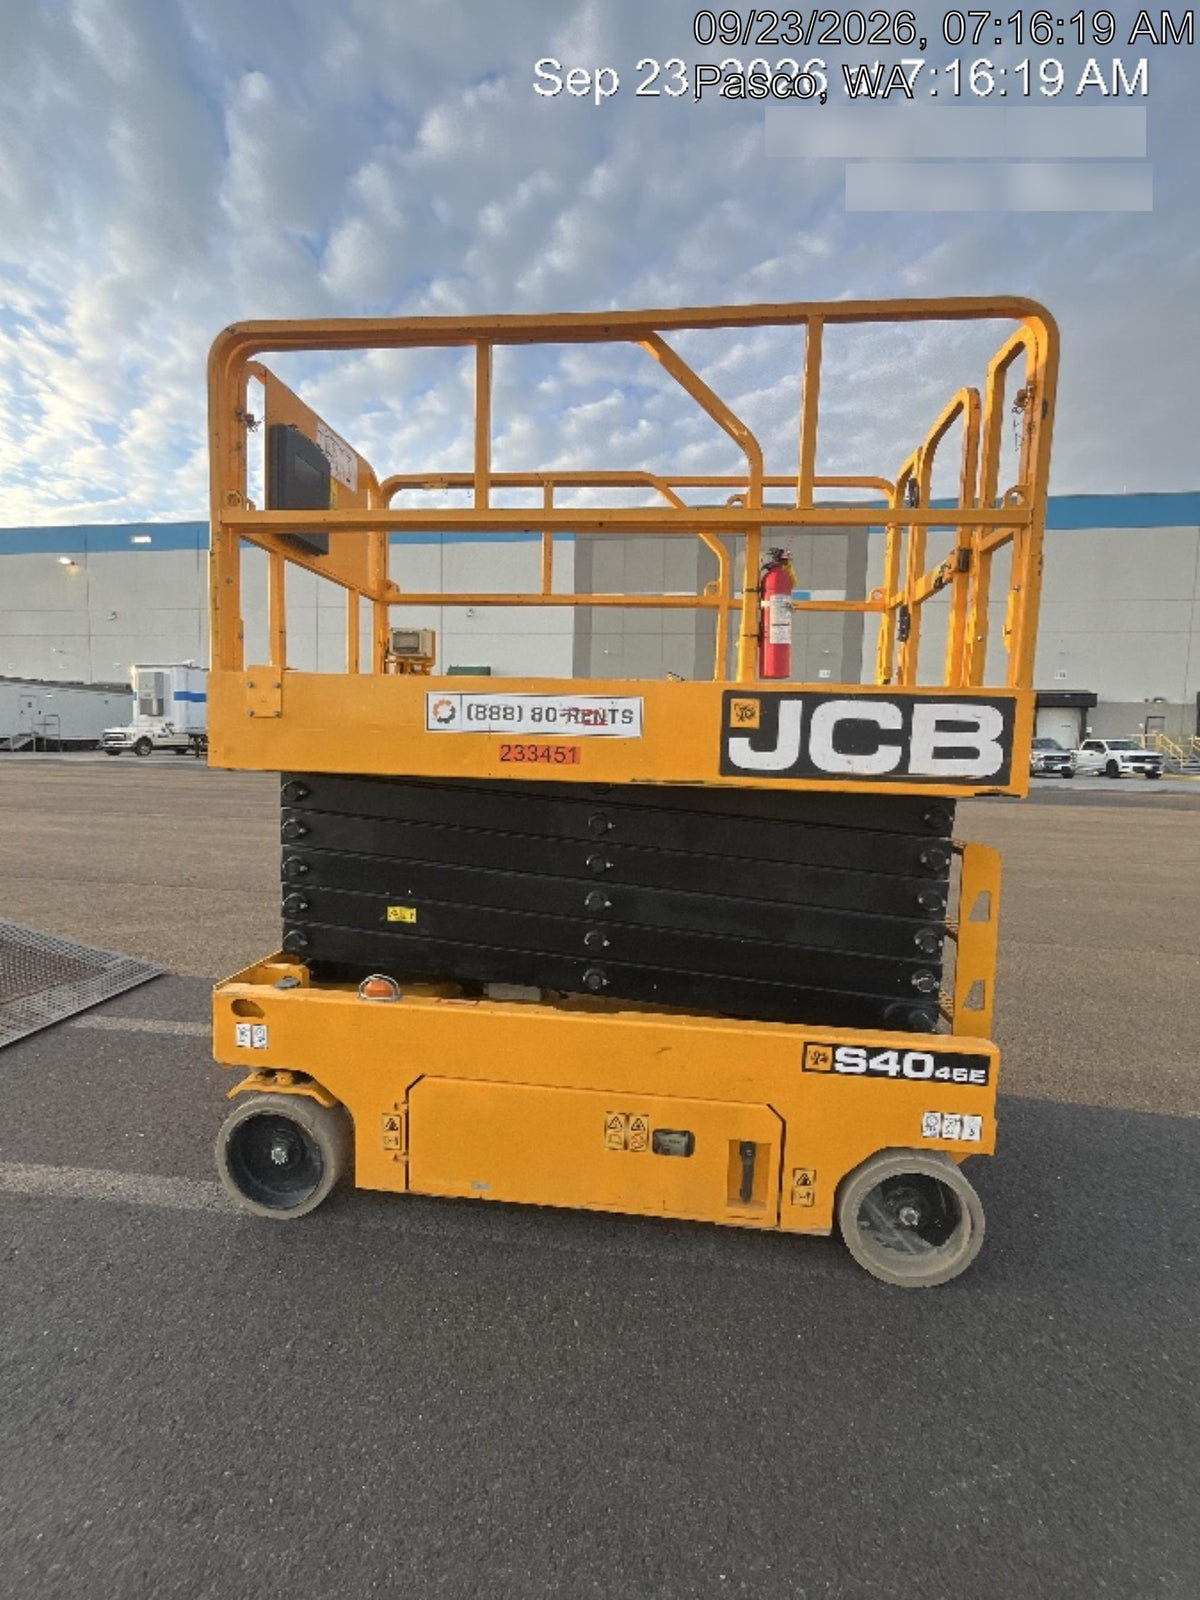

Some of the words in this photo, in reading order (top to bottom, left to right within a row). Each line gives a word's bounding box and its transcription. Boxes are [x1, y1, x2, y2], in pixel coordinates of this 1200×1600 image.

[467, 704, 522, 723] (888)
[728, 700, 1004, 779] JCB
[500, 744, 578, 764] 233451
